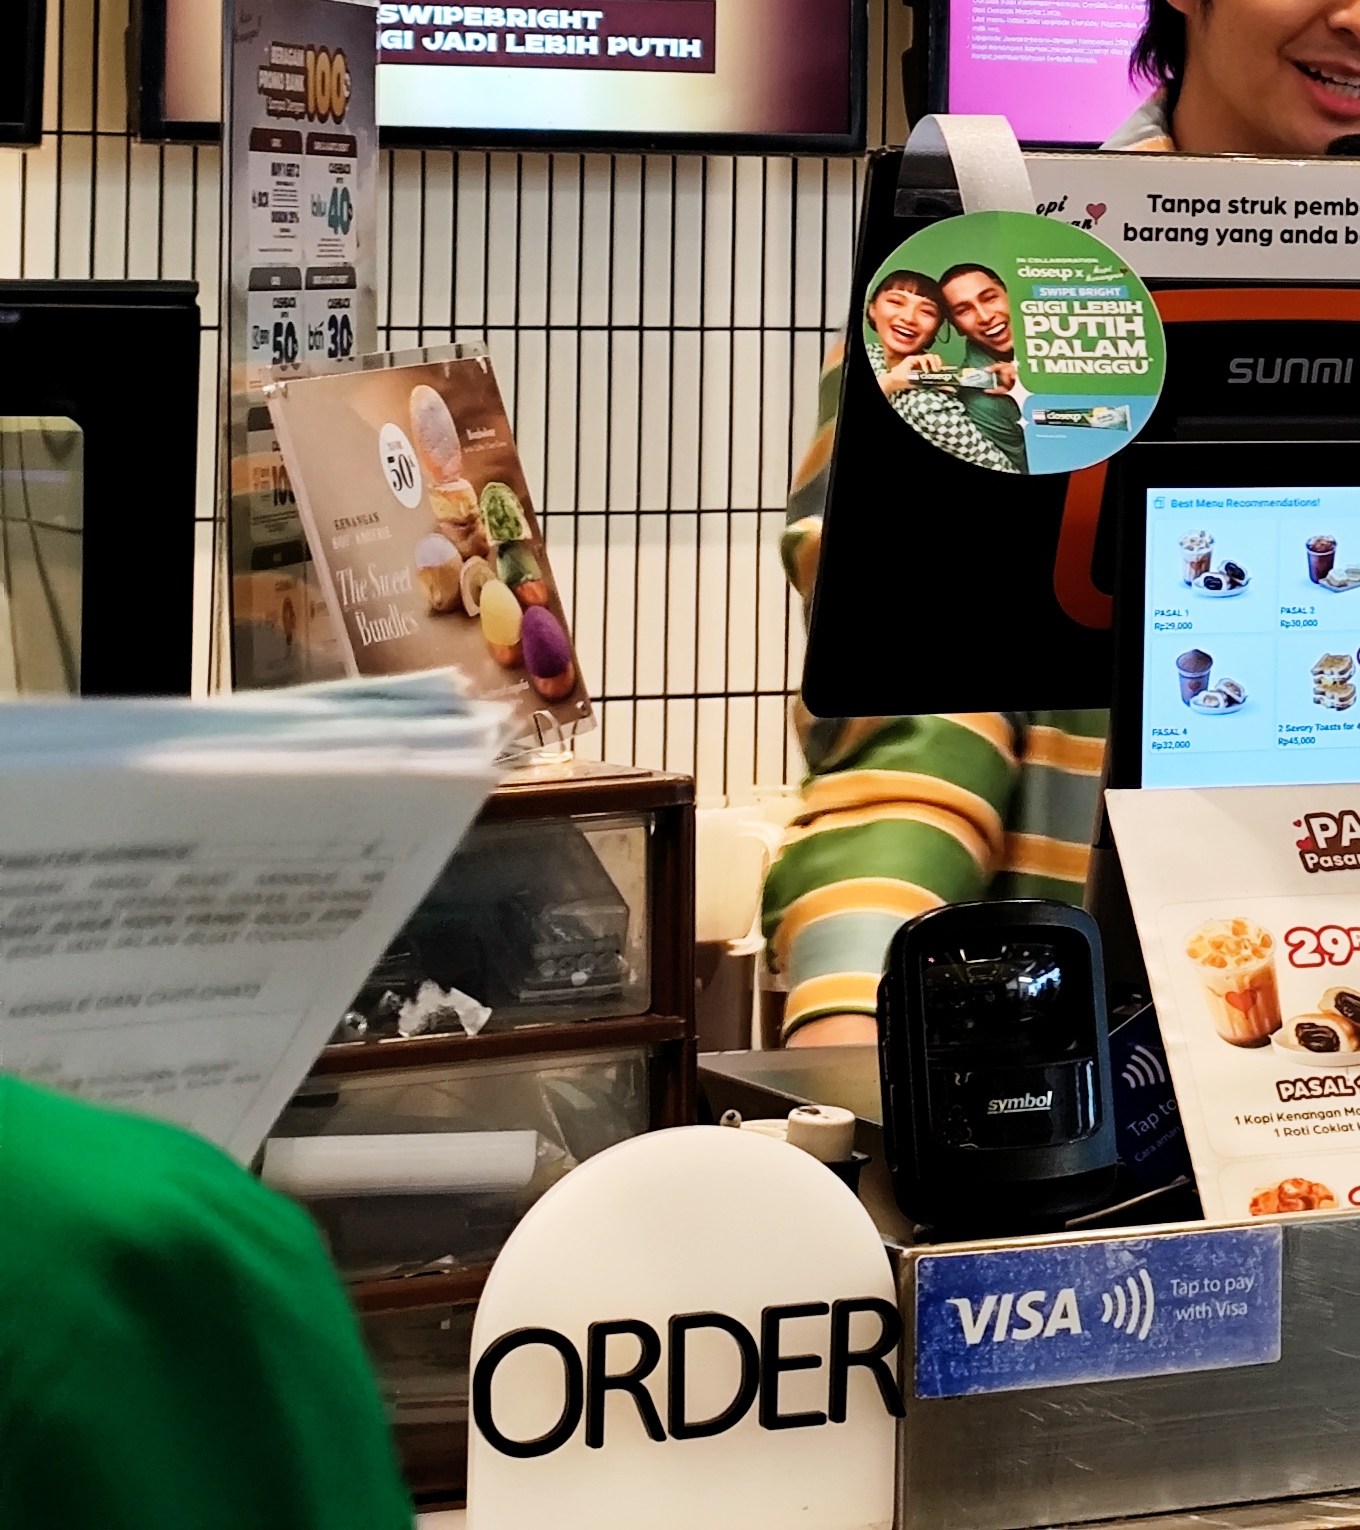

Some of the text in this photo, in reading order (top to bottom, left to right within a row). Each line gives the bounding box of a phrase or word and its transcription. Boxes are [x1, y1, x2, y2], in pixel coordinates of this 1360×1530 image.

[376, 3, 603, 30] SWIPEBRIGHT
[376, 28, 703, 60] GI JADI LEBIH PUTIH
[1035, 195, 1069, 218] opi
[1146, 193, 1221, 219] Tanpa
[1227, 195, 1287, 216] struk
[1123, 222, 1209, 246] barang
[1215, 226, 1273, 247] yang
[1280, 225, 1338, 245] anda
[1017, 265, 1073, 281] closeup
[1039, 287, 1121, 297] SWIPE BRIGHT
[1020, 300, 1143, 314] GIGI LEBIH
[1022, 315, 1145, 338] PUTIH
[1025, 338, 1148, 358] DALAM
[1028, 358, 1039, 373] 1
[1170, 497, 1320, 508] Best Menu Recommendations!
[336, 568, 368, 607] The
[355, 603, 419, 647] Bundles
[1286, 724, 1313, 734] Savory
[1315, 723, 1341, 731] Toasts
[1343, 722, 1355, 730] for
[1276, 1076, 1355, 1102] PASAL
[987, 1090, 1053, 1114] symbol
[1126, 1099, 1178, 1137] Tap to
[1234, 1115, 1241, 1125] 1
[1244, 1112, 1275, 1126] Kopi
[1277, 1109, 1341, 1122] Kenangan
[1274, 1128, 1281, 1137] 1
[1284, 1125, 1310, 1137] Roti
[1313, 1123, 1354, 1135] Coklat
[945, 1275, 1255, 1345] VISA Tap to pay
[1175, 1300, 1248, 1320] with Visa
[472, 1297, 907, 1459] ORDER
